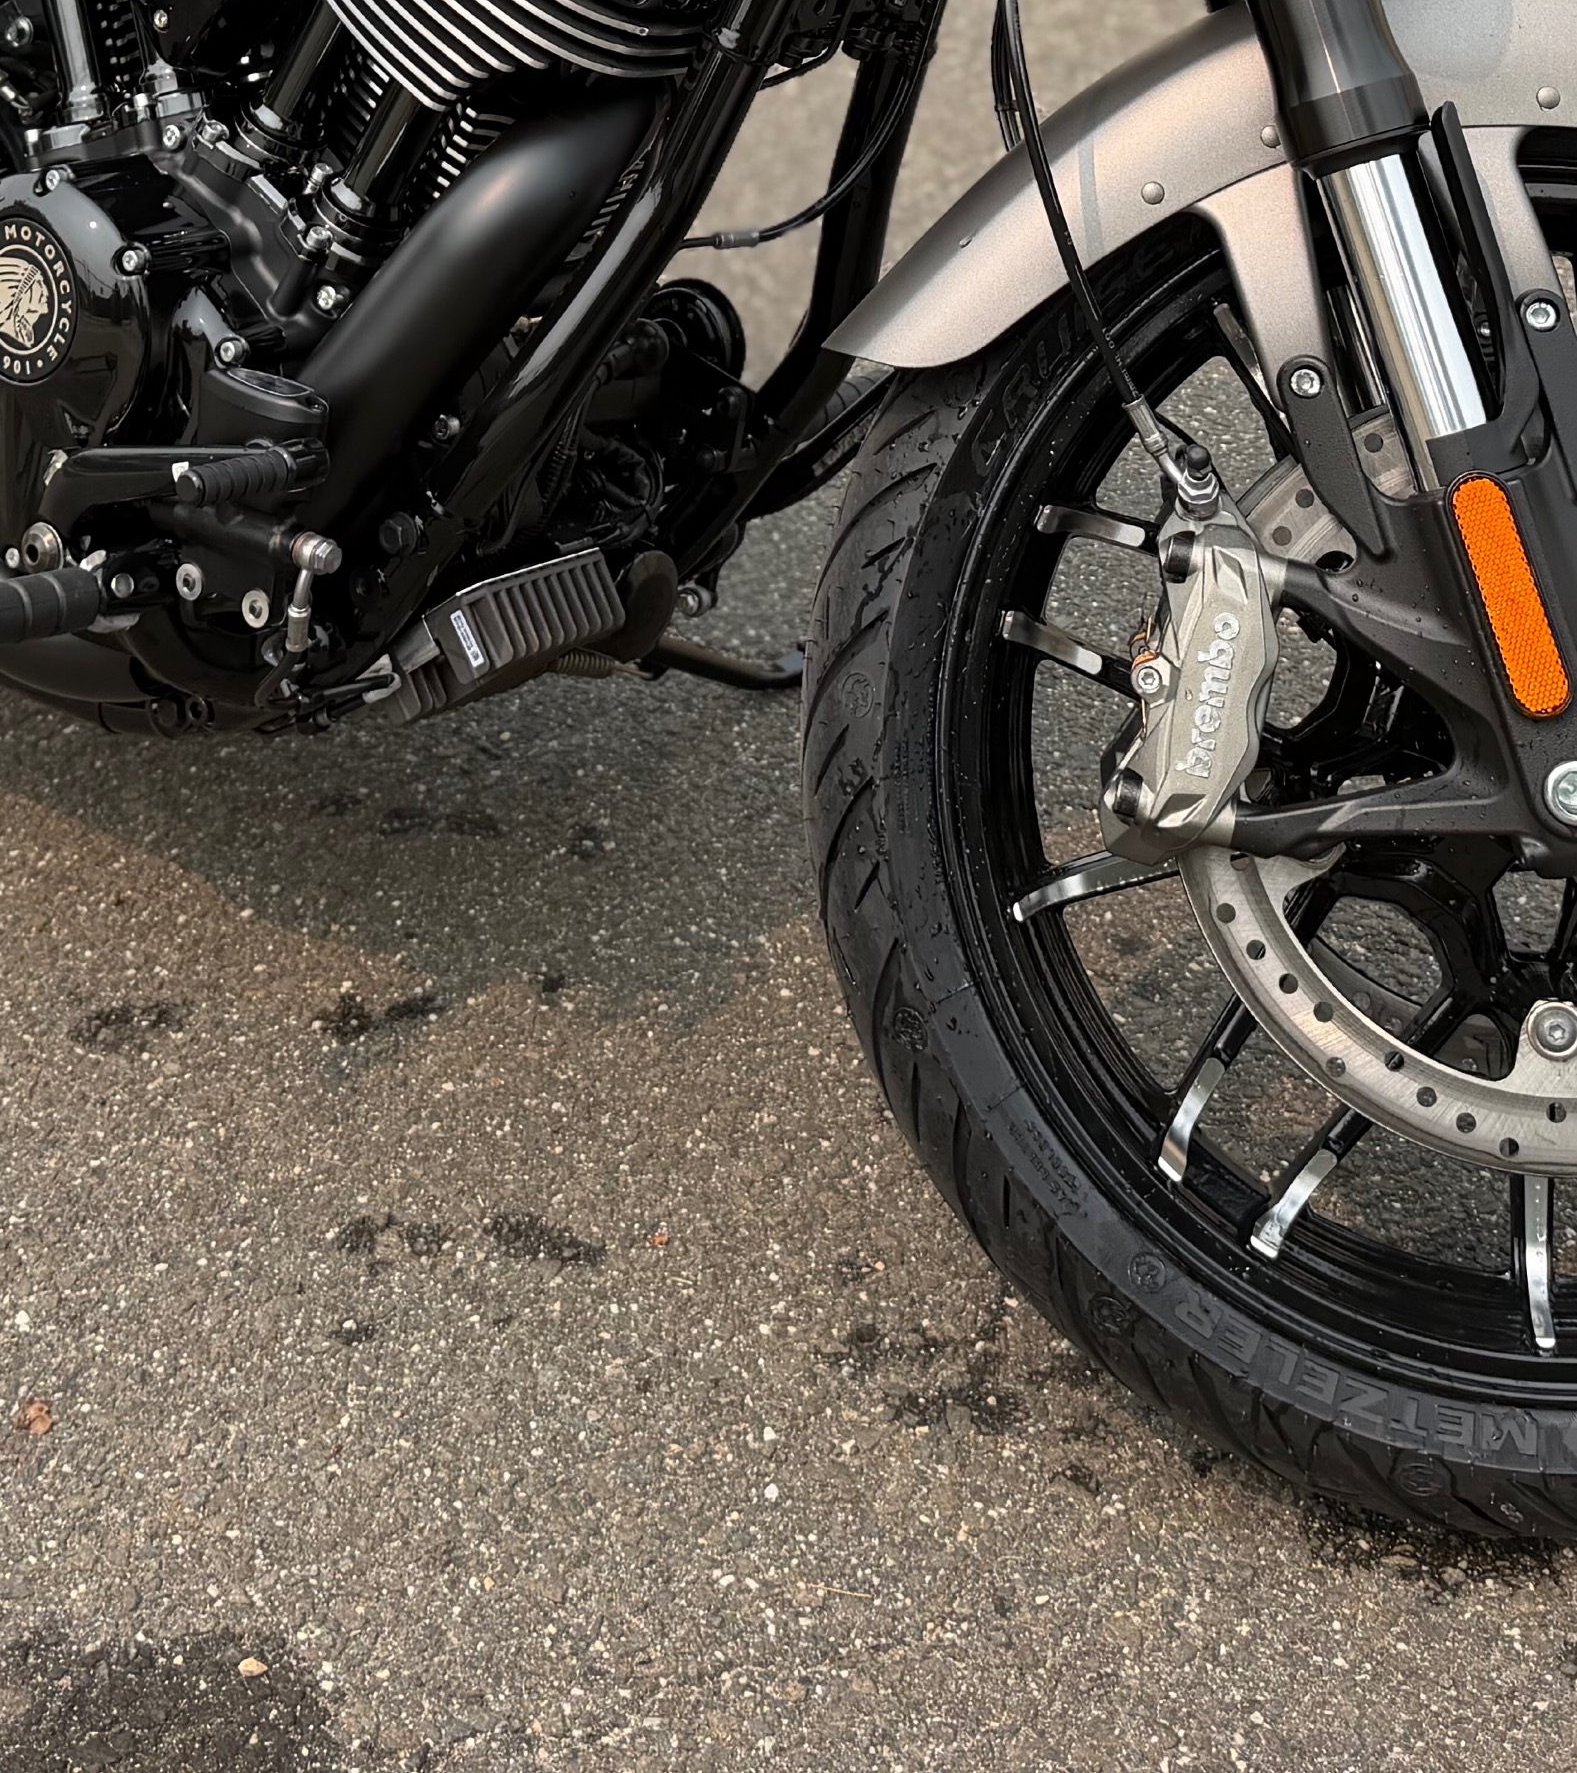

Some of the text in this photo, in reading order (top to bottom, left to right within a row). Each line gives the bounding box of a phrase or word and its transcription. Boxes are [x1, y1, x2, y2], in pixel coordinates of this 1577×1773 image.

[4, 224, 72, 360] MOTORCYCLE
[1175, 611, 1241, 780] brembo
[1175, 1289, 1540, 1457] METZELER
